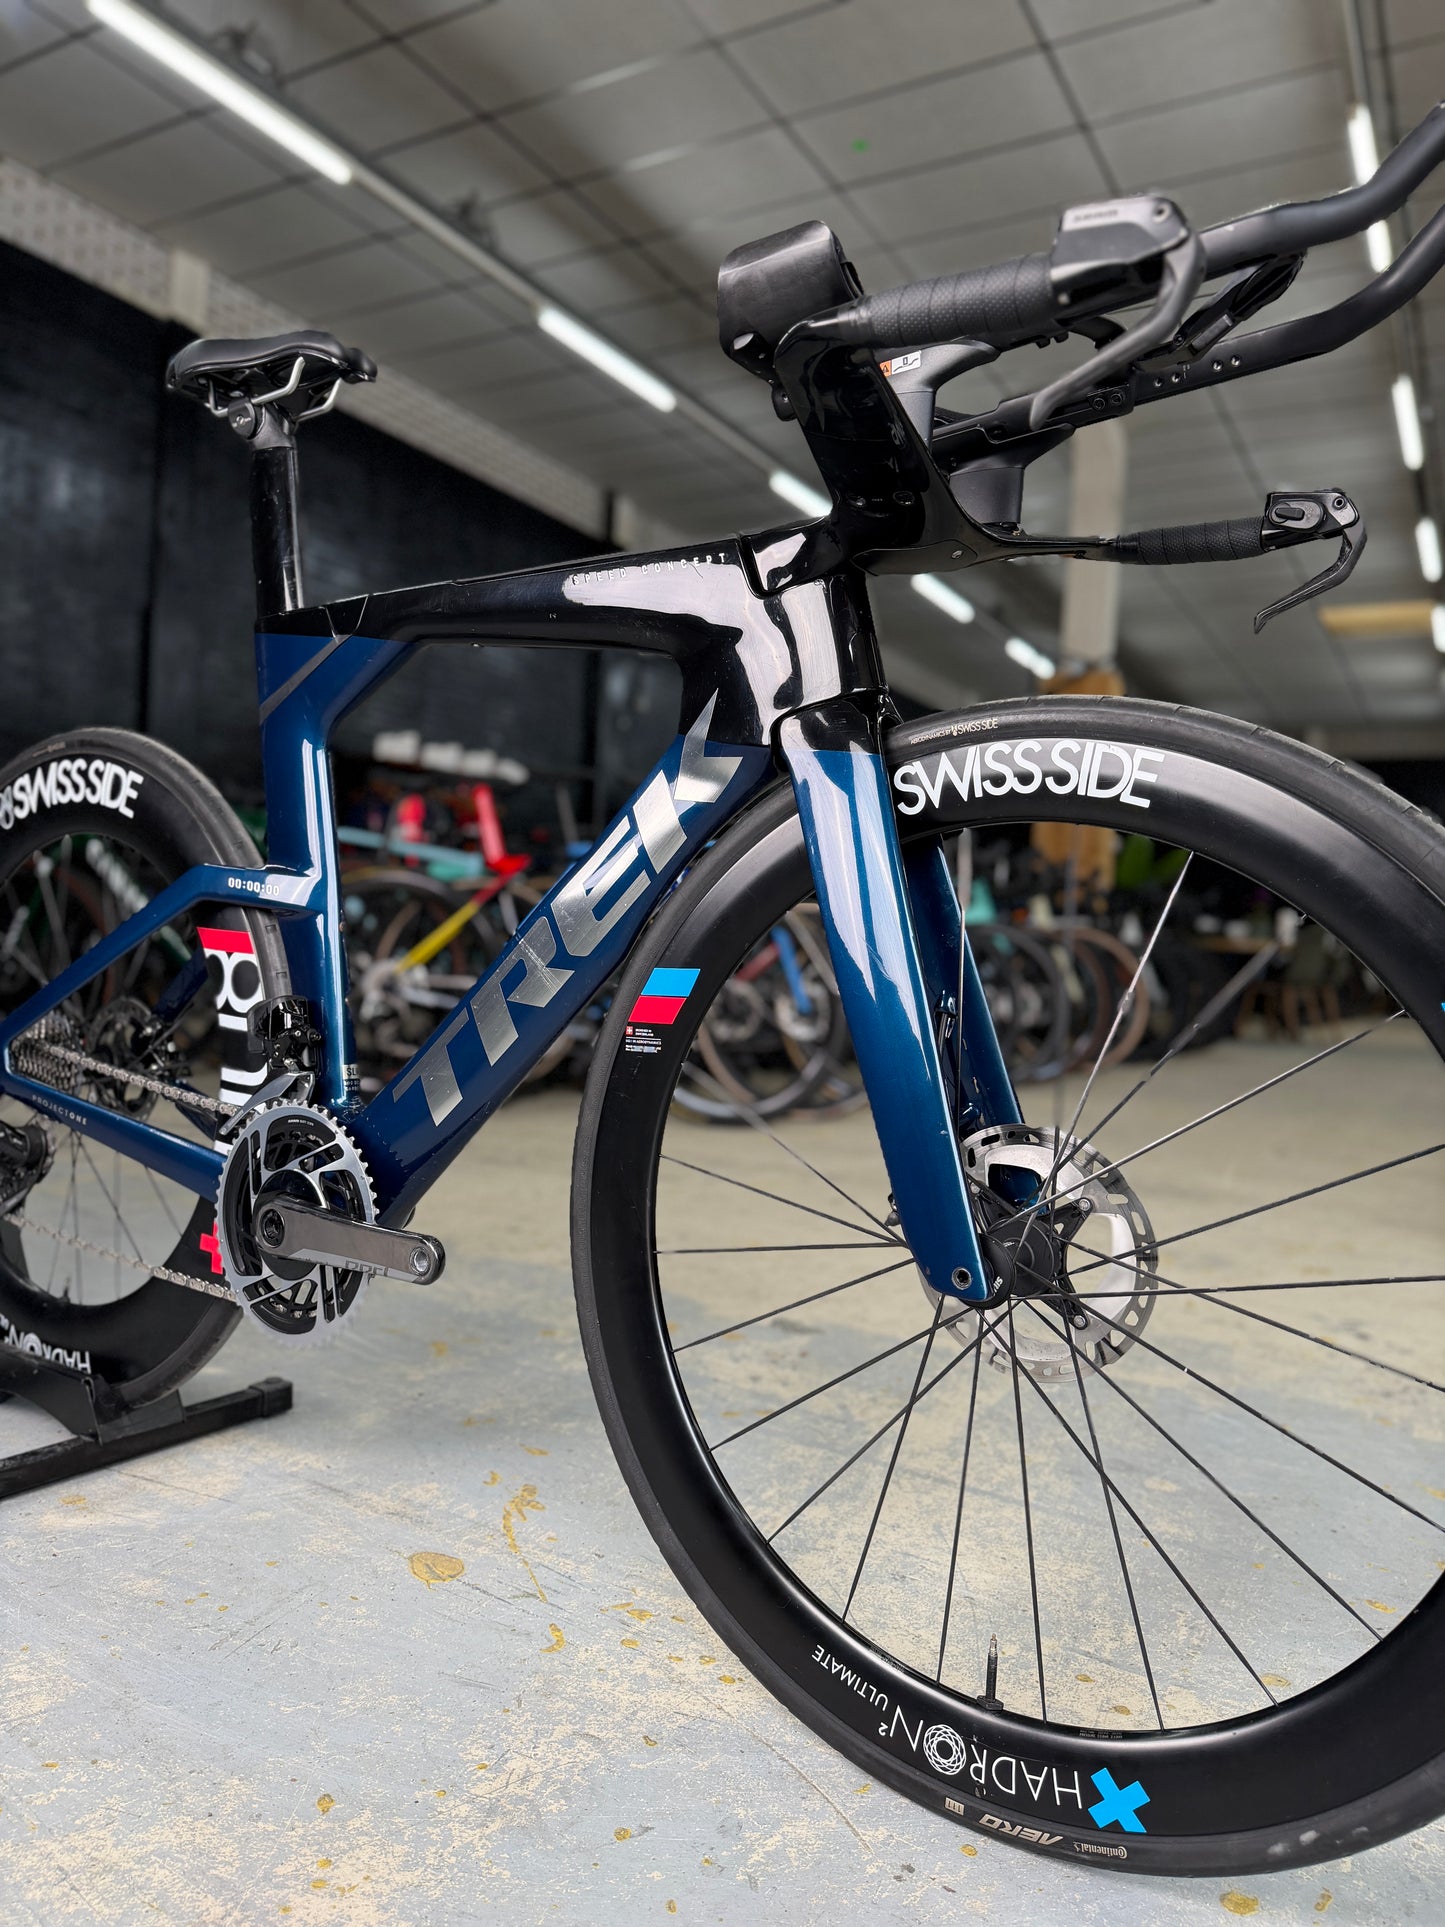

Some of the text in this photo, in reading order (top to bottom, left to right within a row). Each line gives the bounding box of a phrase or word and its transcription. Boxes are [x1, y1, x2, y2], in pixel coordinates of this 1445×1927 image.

[573, 553, 725, 585] SPEED CONCEPT
[958, 721, 981, 735] SWISS
[981, 718, 999, 730] SIDE
[13, 758, 144, 819] SWISS SIDE
[894, 739, 1165, 816] SWISS SIDE
[228, 877, 280, 896] 00:00:00
[393, 688, 743, 1127] TREK
[811, 1644, 889, 1713] ULTIMATE
[979, 1813, 1064, 1846] AERO
[1079, 1842, 1128, 1860] Continental
